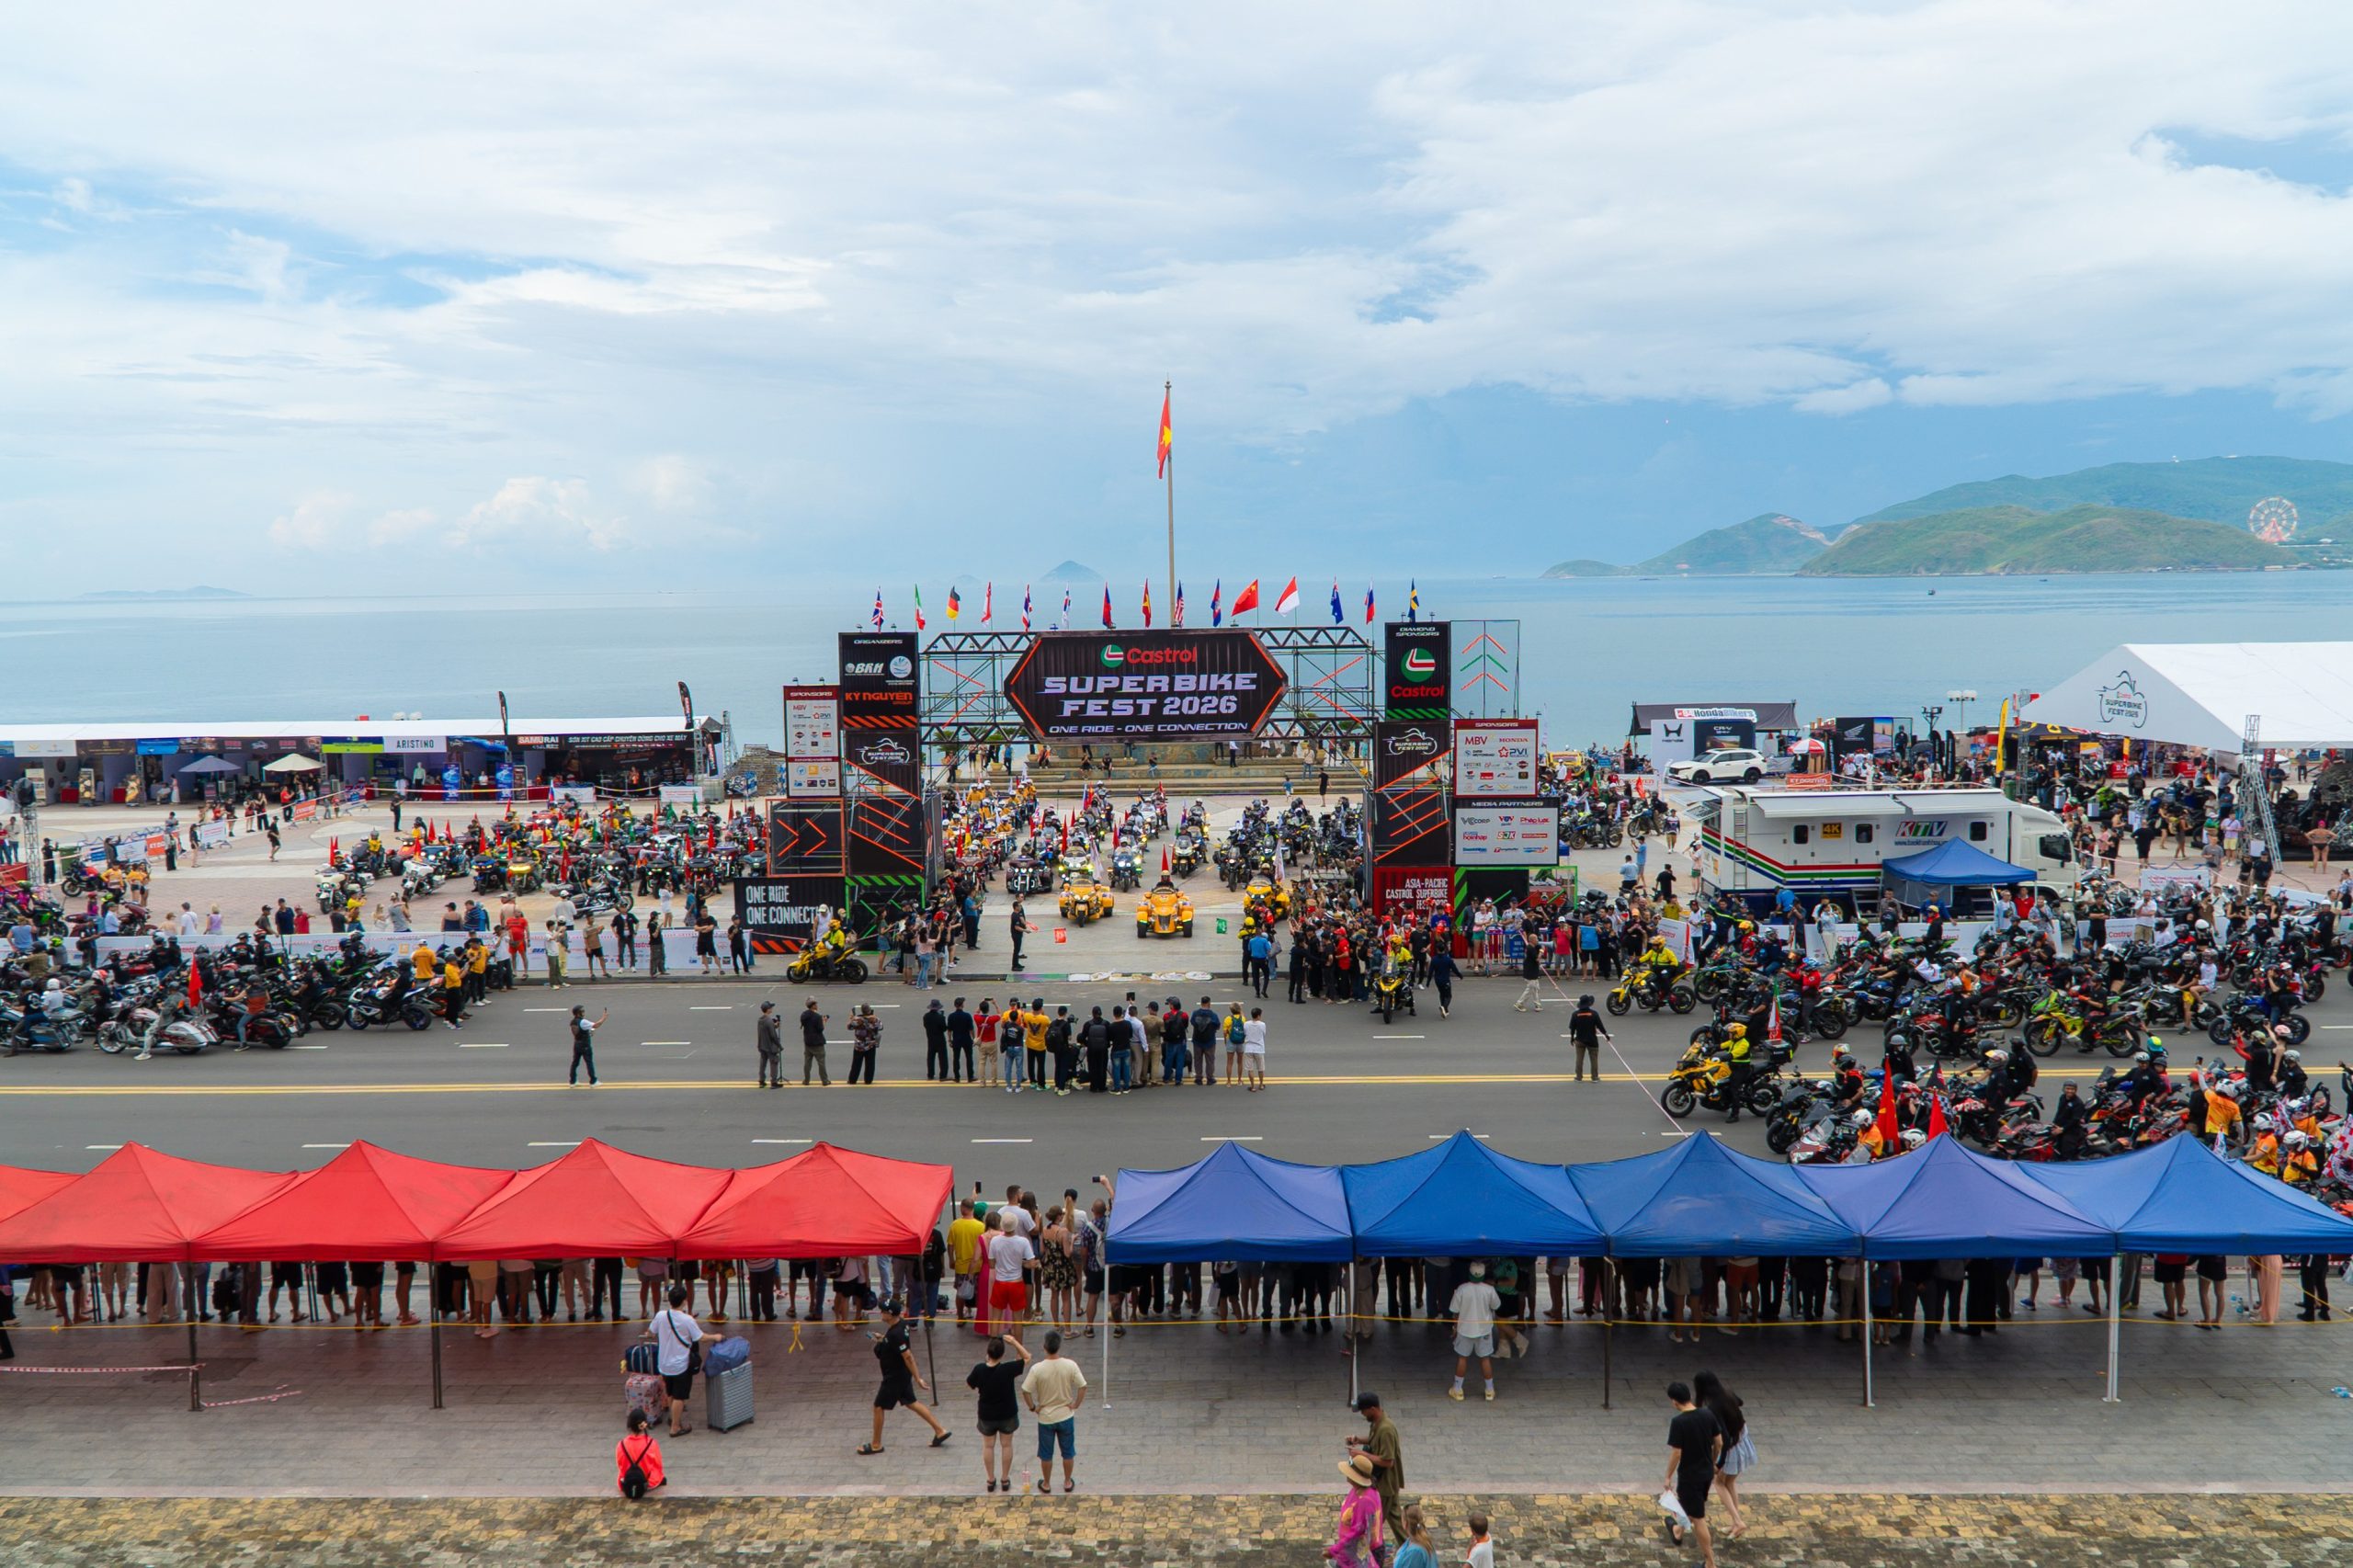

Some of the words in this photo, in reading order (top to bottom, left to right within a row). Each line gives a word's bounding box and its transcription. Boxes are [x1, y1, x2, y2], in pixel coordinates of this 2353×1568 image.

[1126, 646, 1198, 664] Castrol
[1038, 673, 1257, 695] SUPERBIKE
[1391, 685, 1445, 698] Castrol
[1056, 698, 1157, 717] FEST
[1162, 696, 1237, 715] 2026
[1050, 724, 1079, 733] ONE
[1081, 724, 1114, 733] RIDE
[1124, 723, 1154, 733] ONE
[1156, 722, 1248, 732] CONNECTION
[396, 739, 435, 748] ARISTINO
[517, 736, 559, 744] SAMURAI
[1465, 735, 1488, 745] MBV
[1824, 824, 1840, 834] 4K
[1896, 822, 1947, 837] KTV
[745, 886, 767, 903] ONE
[768, 886, 790, 903] RIDE
[1386, 889, 1414, 899] CASTROL
[1415, 888, 1449, 899] SUPERBIKE
[746, 906, 767, 925] ONE
